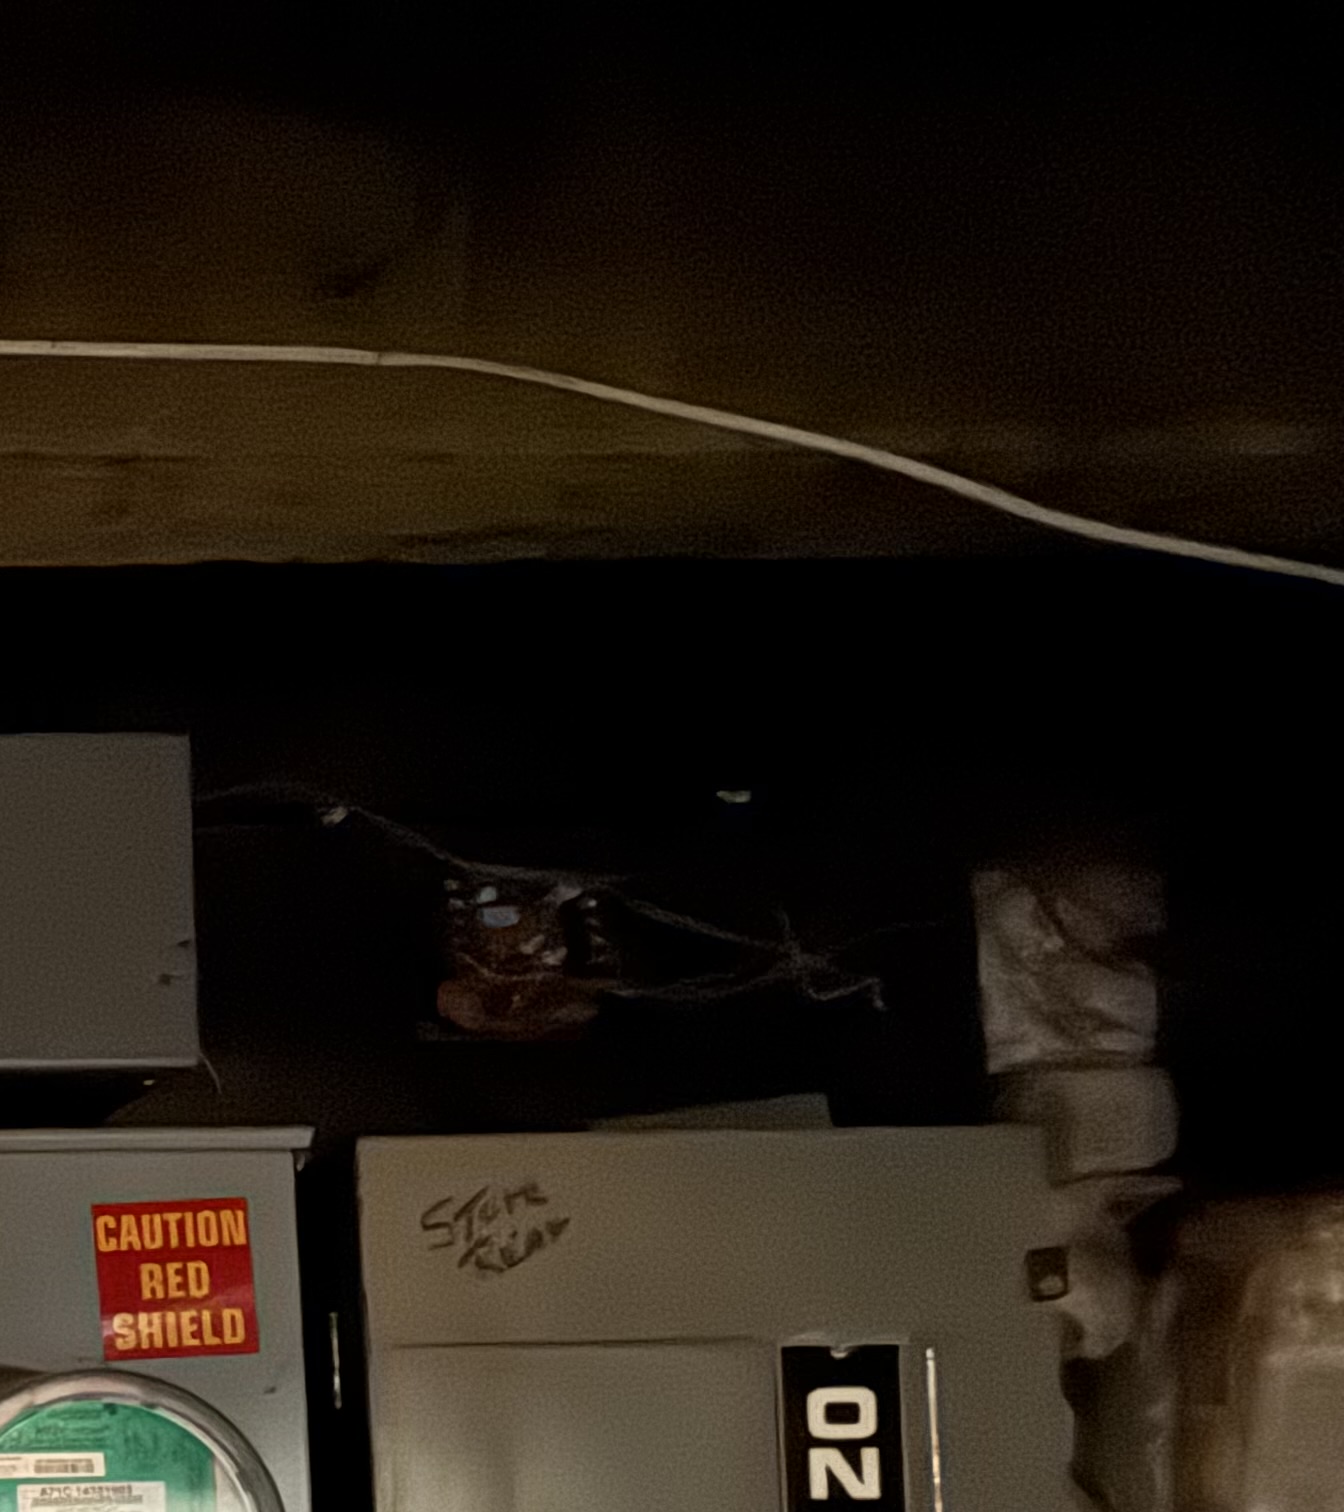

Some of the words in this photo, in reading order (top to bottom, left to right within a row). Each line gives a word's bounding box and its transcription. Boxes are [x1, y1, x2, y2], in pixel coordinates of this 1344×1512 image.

[95, 1209, 248, 1252] CAUTION
[139, 1259, 211, 1301] RED
[112, 1308, 246, 1351] SHIELD
[806, 1386, 882, 1500] ON
